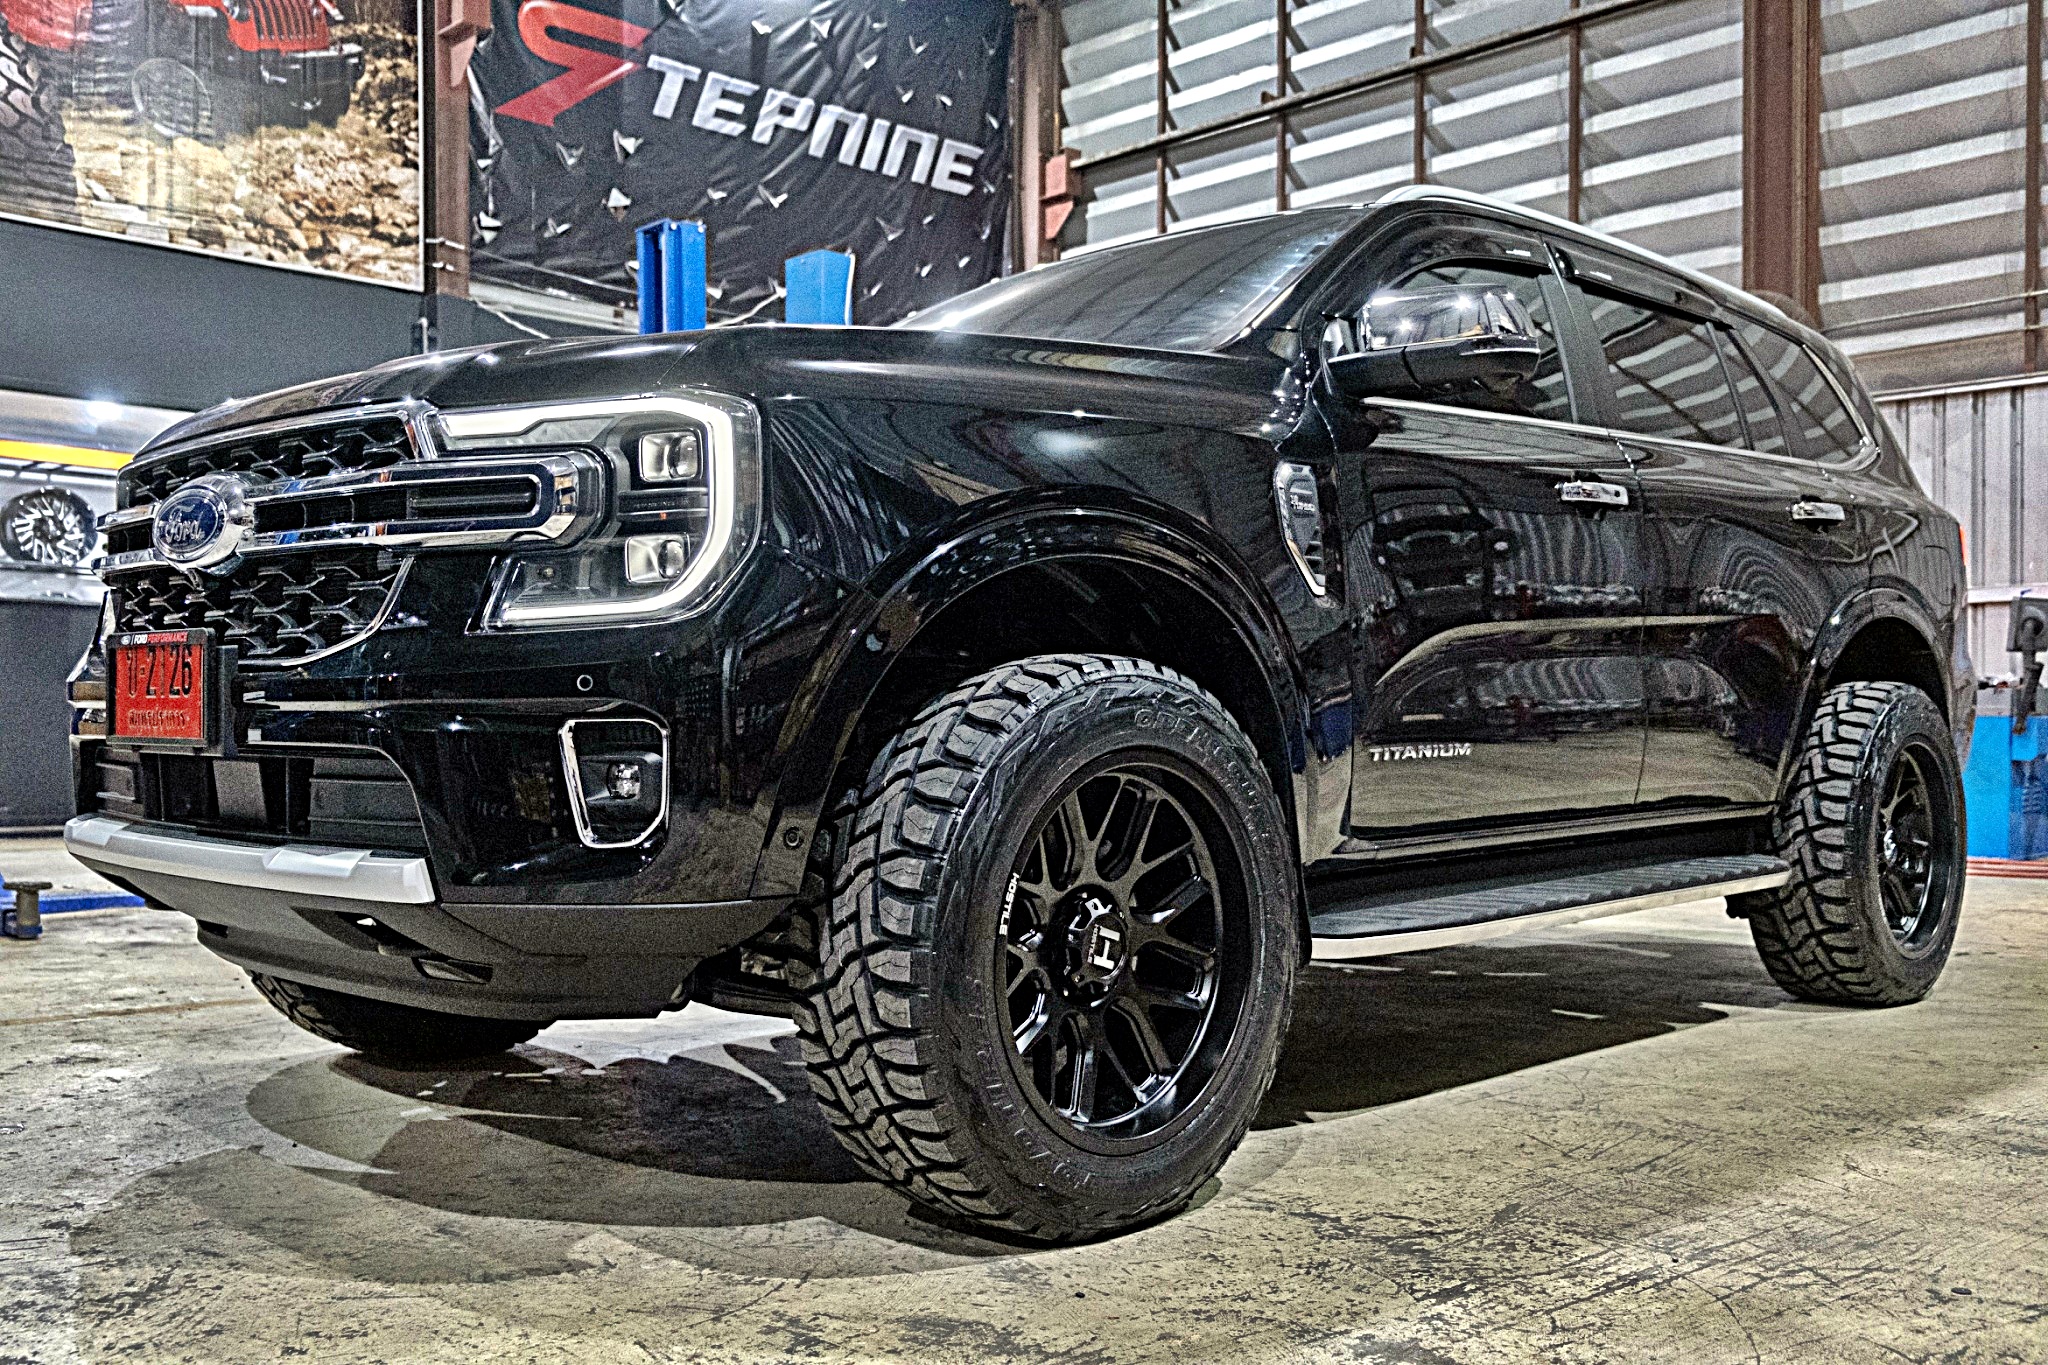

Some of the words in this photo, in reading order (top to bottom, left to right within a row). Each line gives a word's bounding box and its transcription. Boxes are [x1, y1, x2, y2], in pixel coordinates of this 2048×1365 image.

[162, 504, 206, 543] Ford
[133, 633, 148, 645] FORD
[1369, 743, 1471, 761] TITANIUM
[998, 872, 1020, 936] HOSTILE
